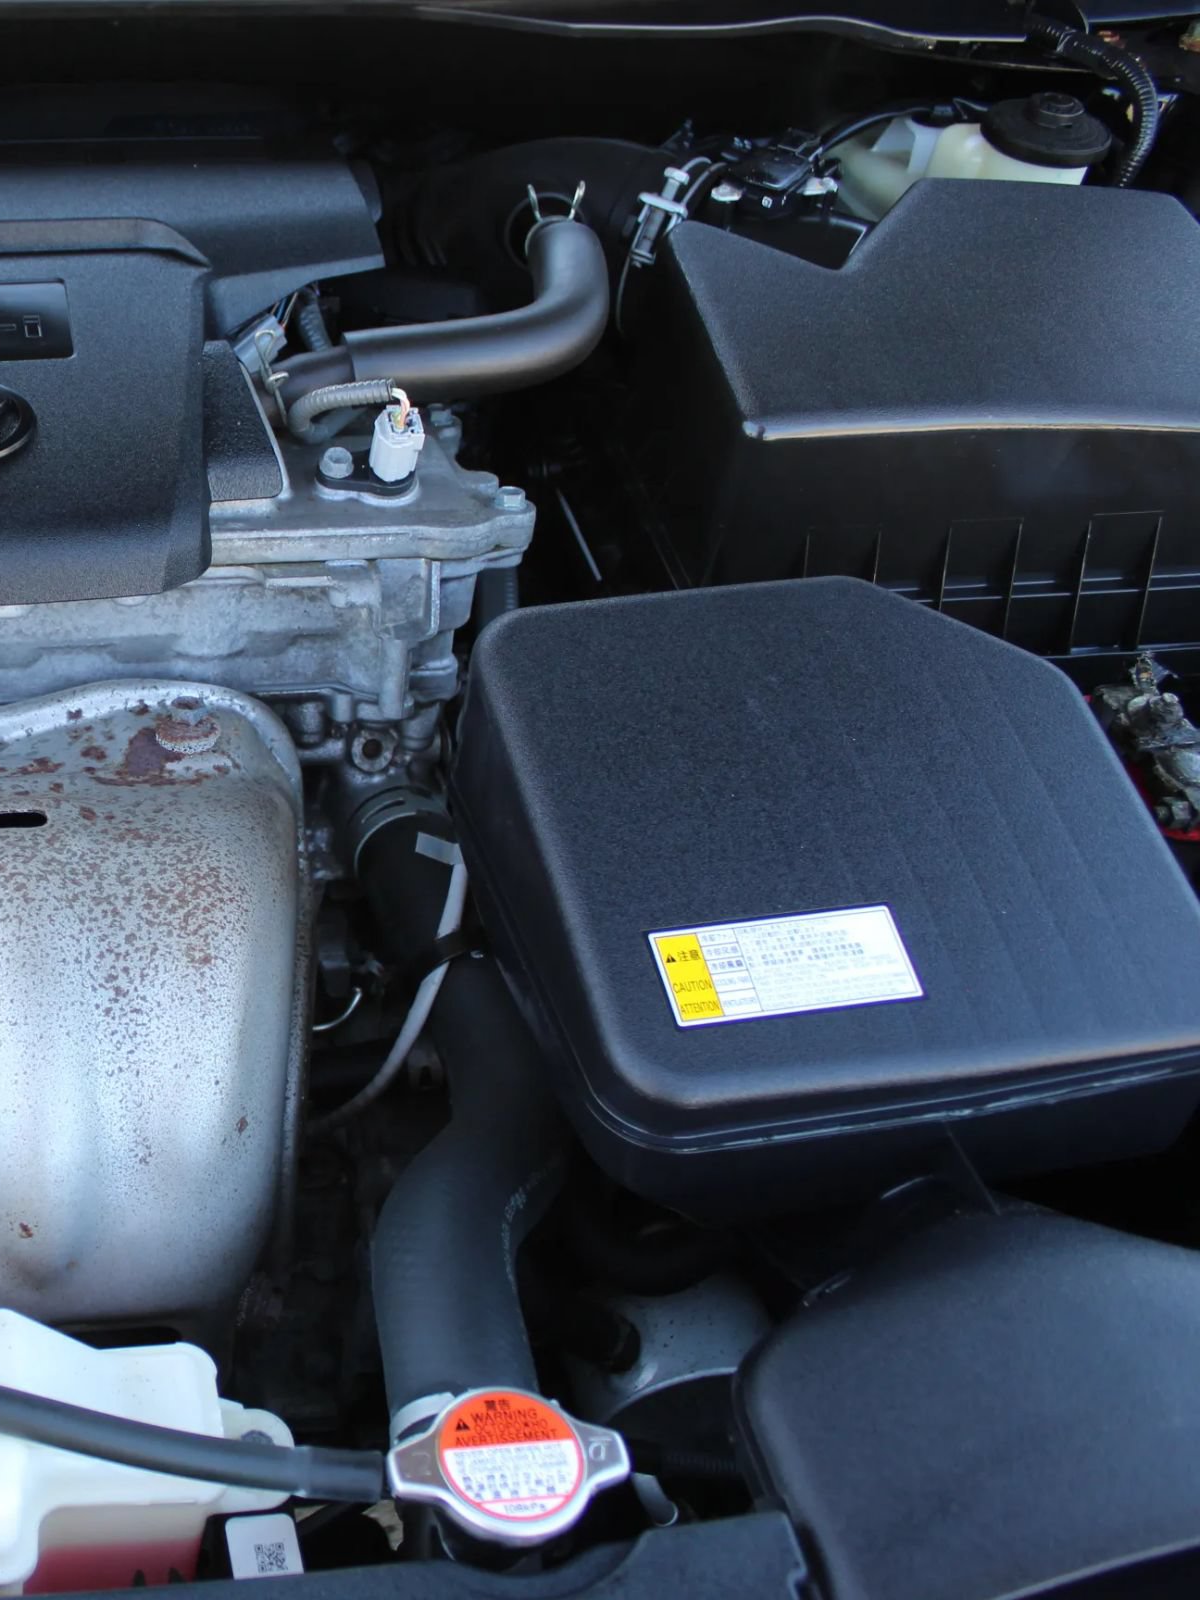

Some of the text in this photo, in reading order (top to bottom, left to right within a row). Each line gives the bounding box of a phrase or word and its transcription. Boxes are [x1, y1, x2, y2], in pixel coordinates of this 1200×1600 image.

[677, 949, 701, 962] 注意
[673, 979, 713, 994] CAUTION
[680, 1000, 721, 1014] ATTENTION
[470, 1408, 538, 1424] WARNING
[455, 1428, 557, 1447] AVERTISSEMENT
